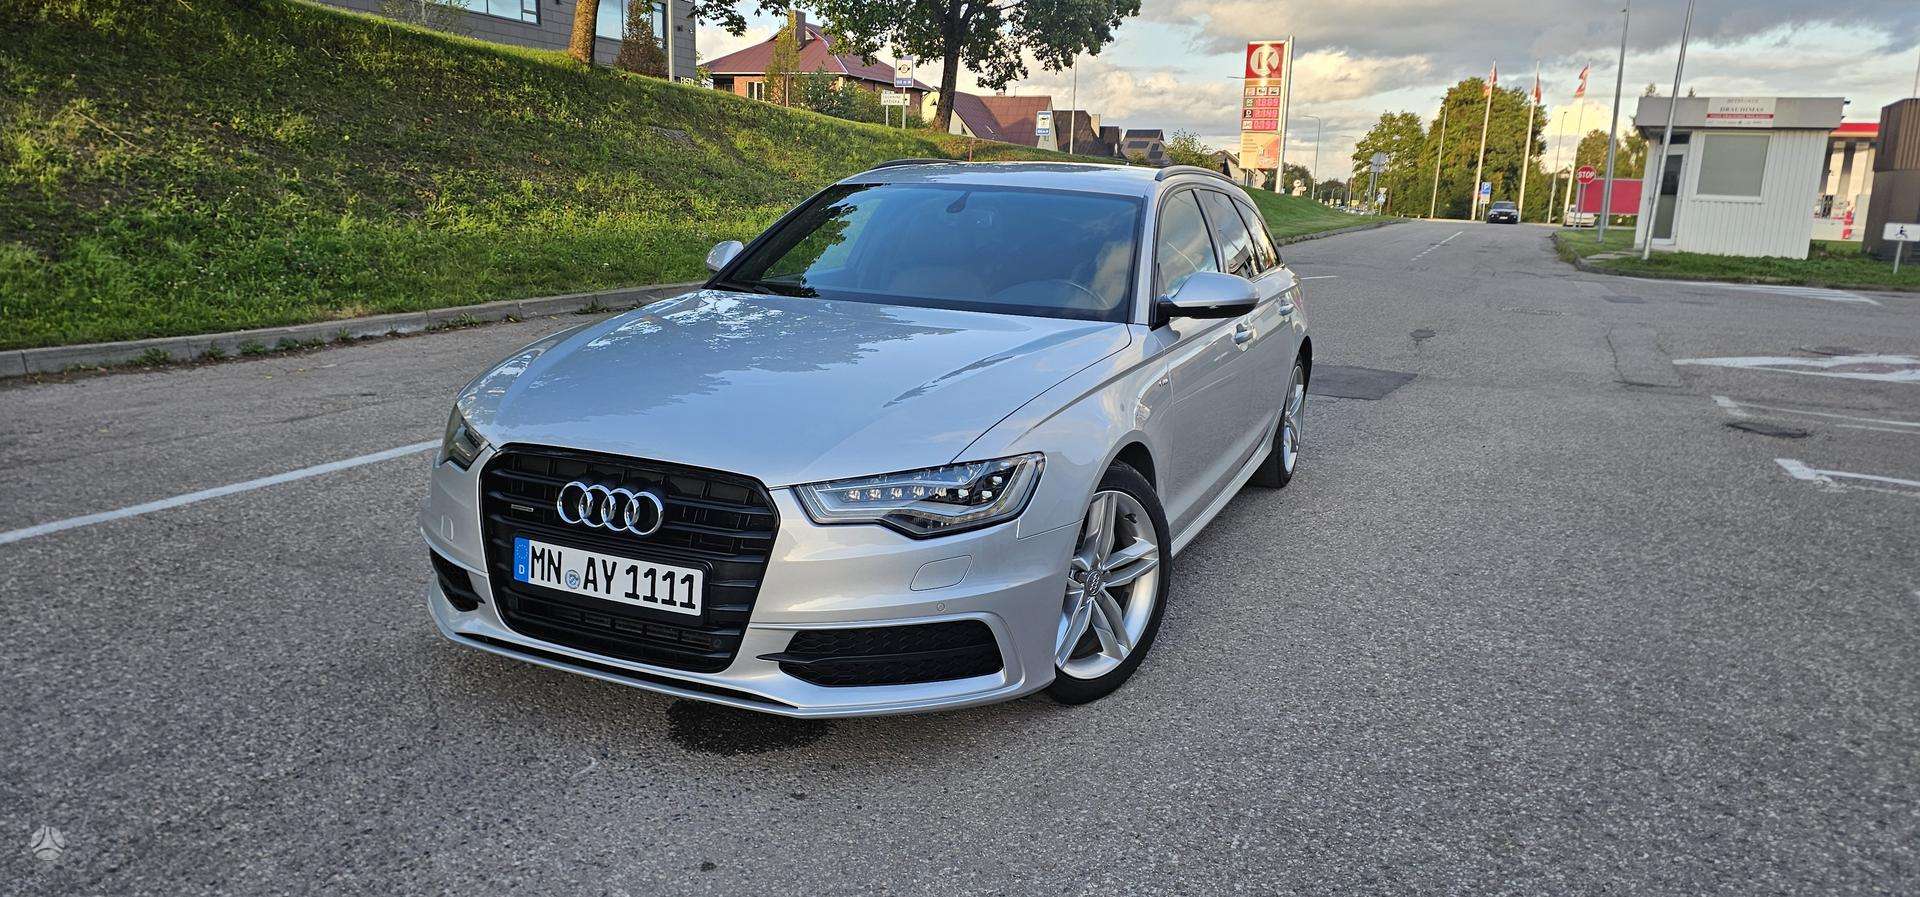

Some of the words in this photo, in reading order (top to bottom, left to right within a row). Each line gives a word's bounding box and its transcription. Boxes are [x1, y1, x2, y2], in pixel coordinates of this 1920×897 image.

[519, 565, 525, 574] D
[531, 545, 562, 584] MN
[583, 556, 618, 594] AY
[624, 564, 696, 610] 1111
